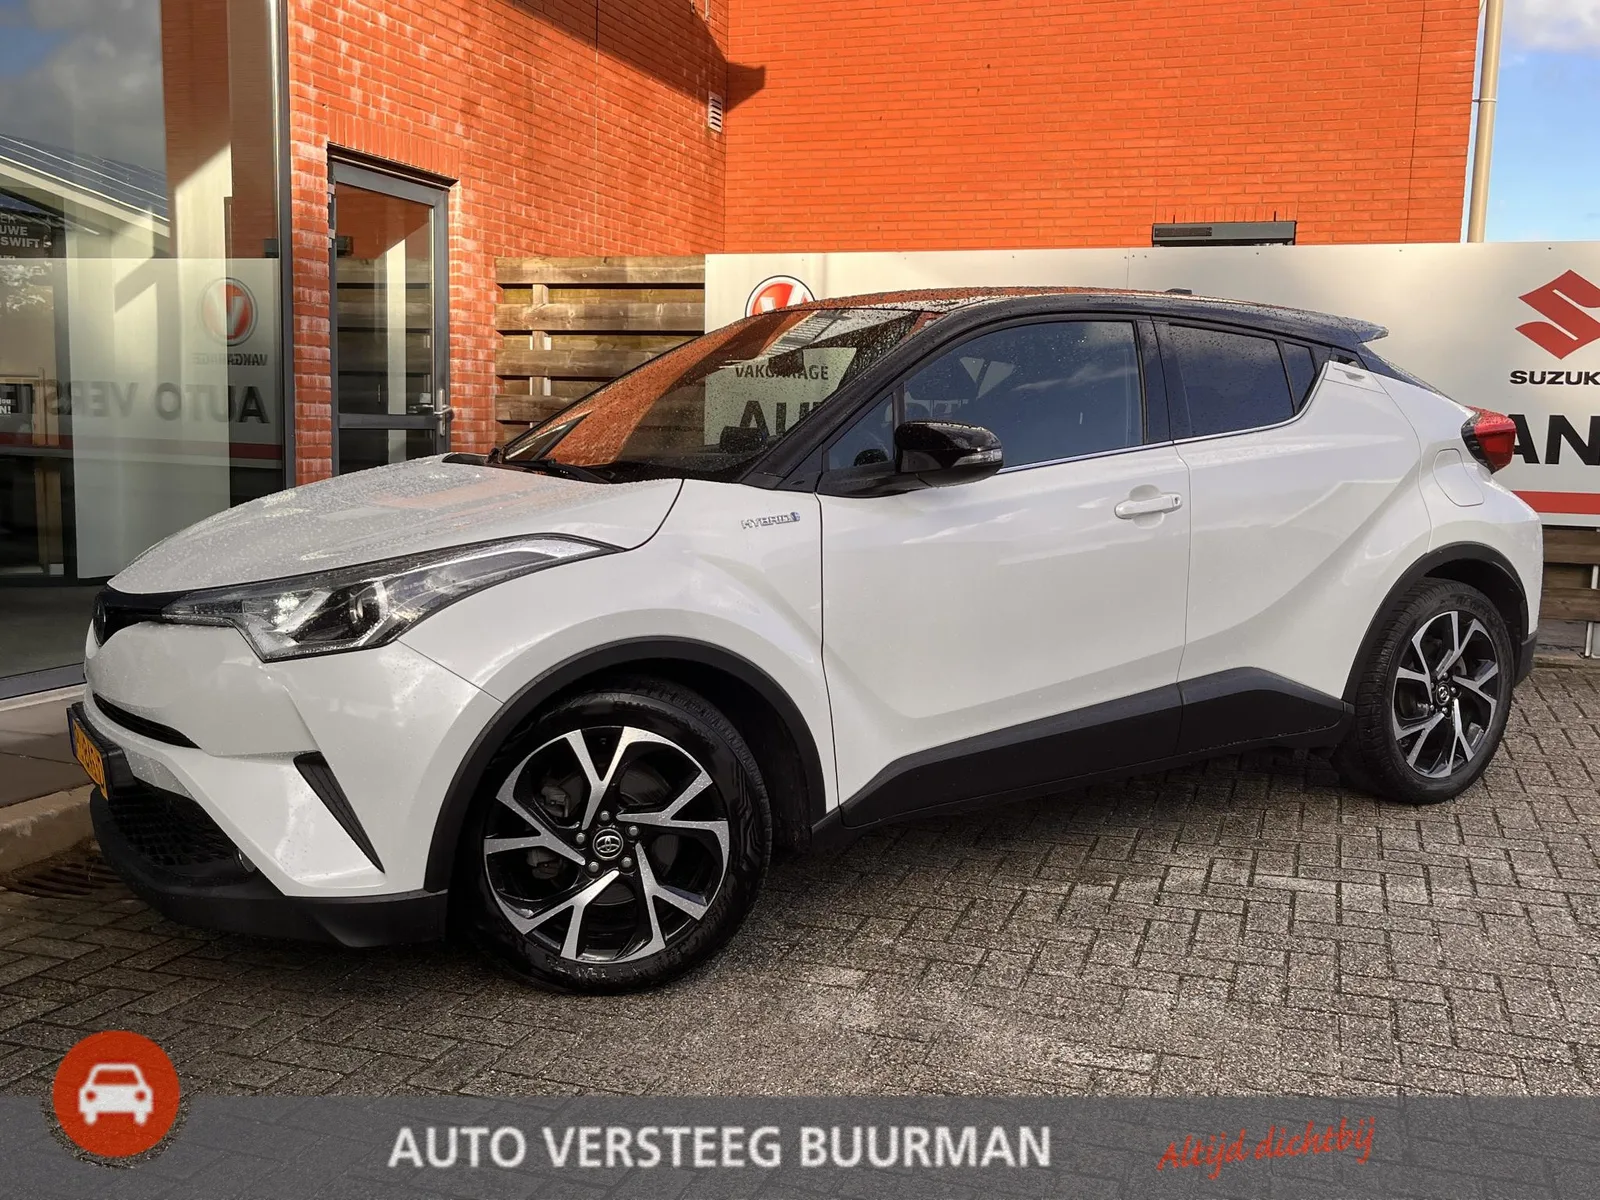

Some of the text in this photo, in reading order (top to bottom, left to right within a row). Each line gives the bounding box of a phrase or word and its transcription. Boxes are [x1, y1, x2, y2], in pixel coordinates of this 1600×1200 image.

[0, 236, 40, 248] SWIFT
[1509, 370, 1600, 386] SUZUK
[741, 513, 791, 530] HYBRID
